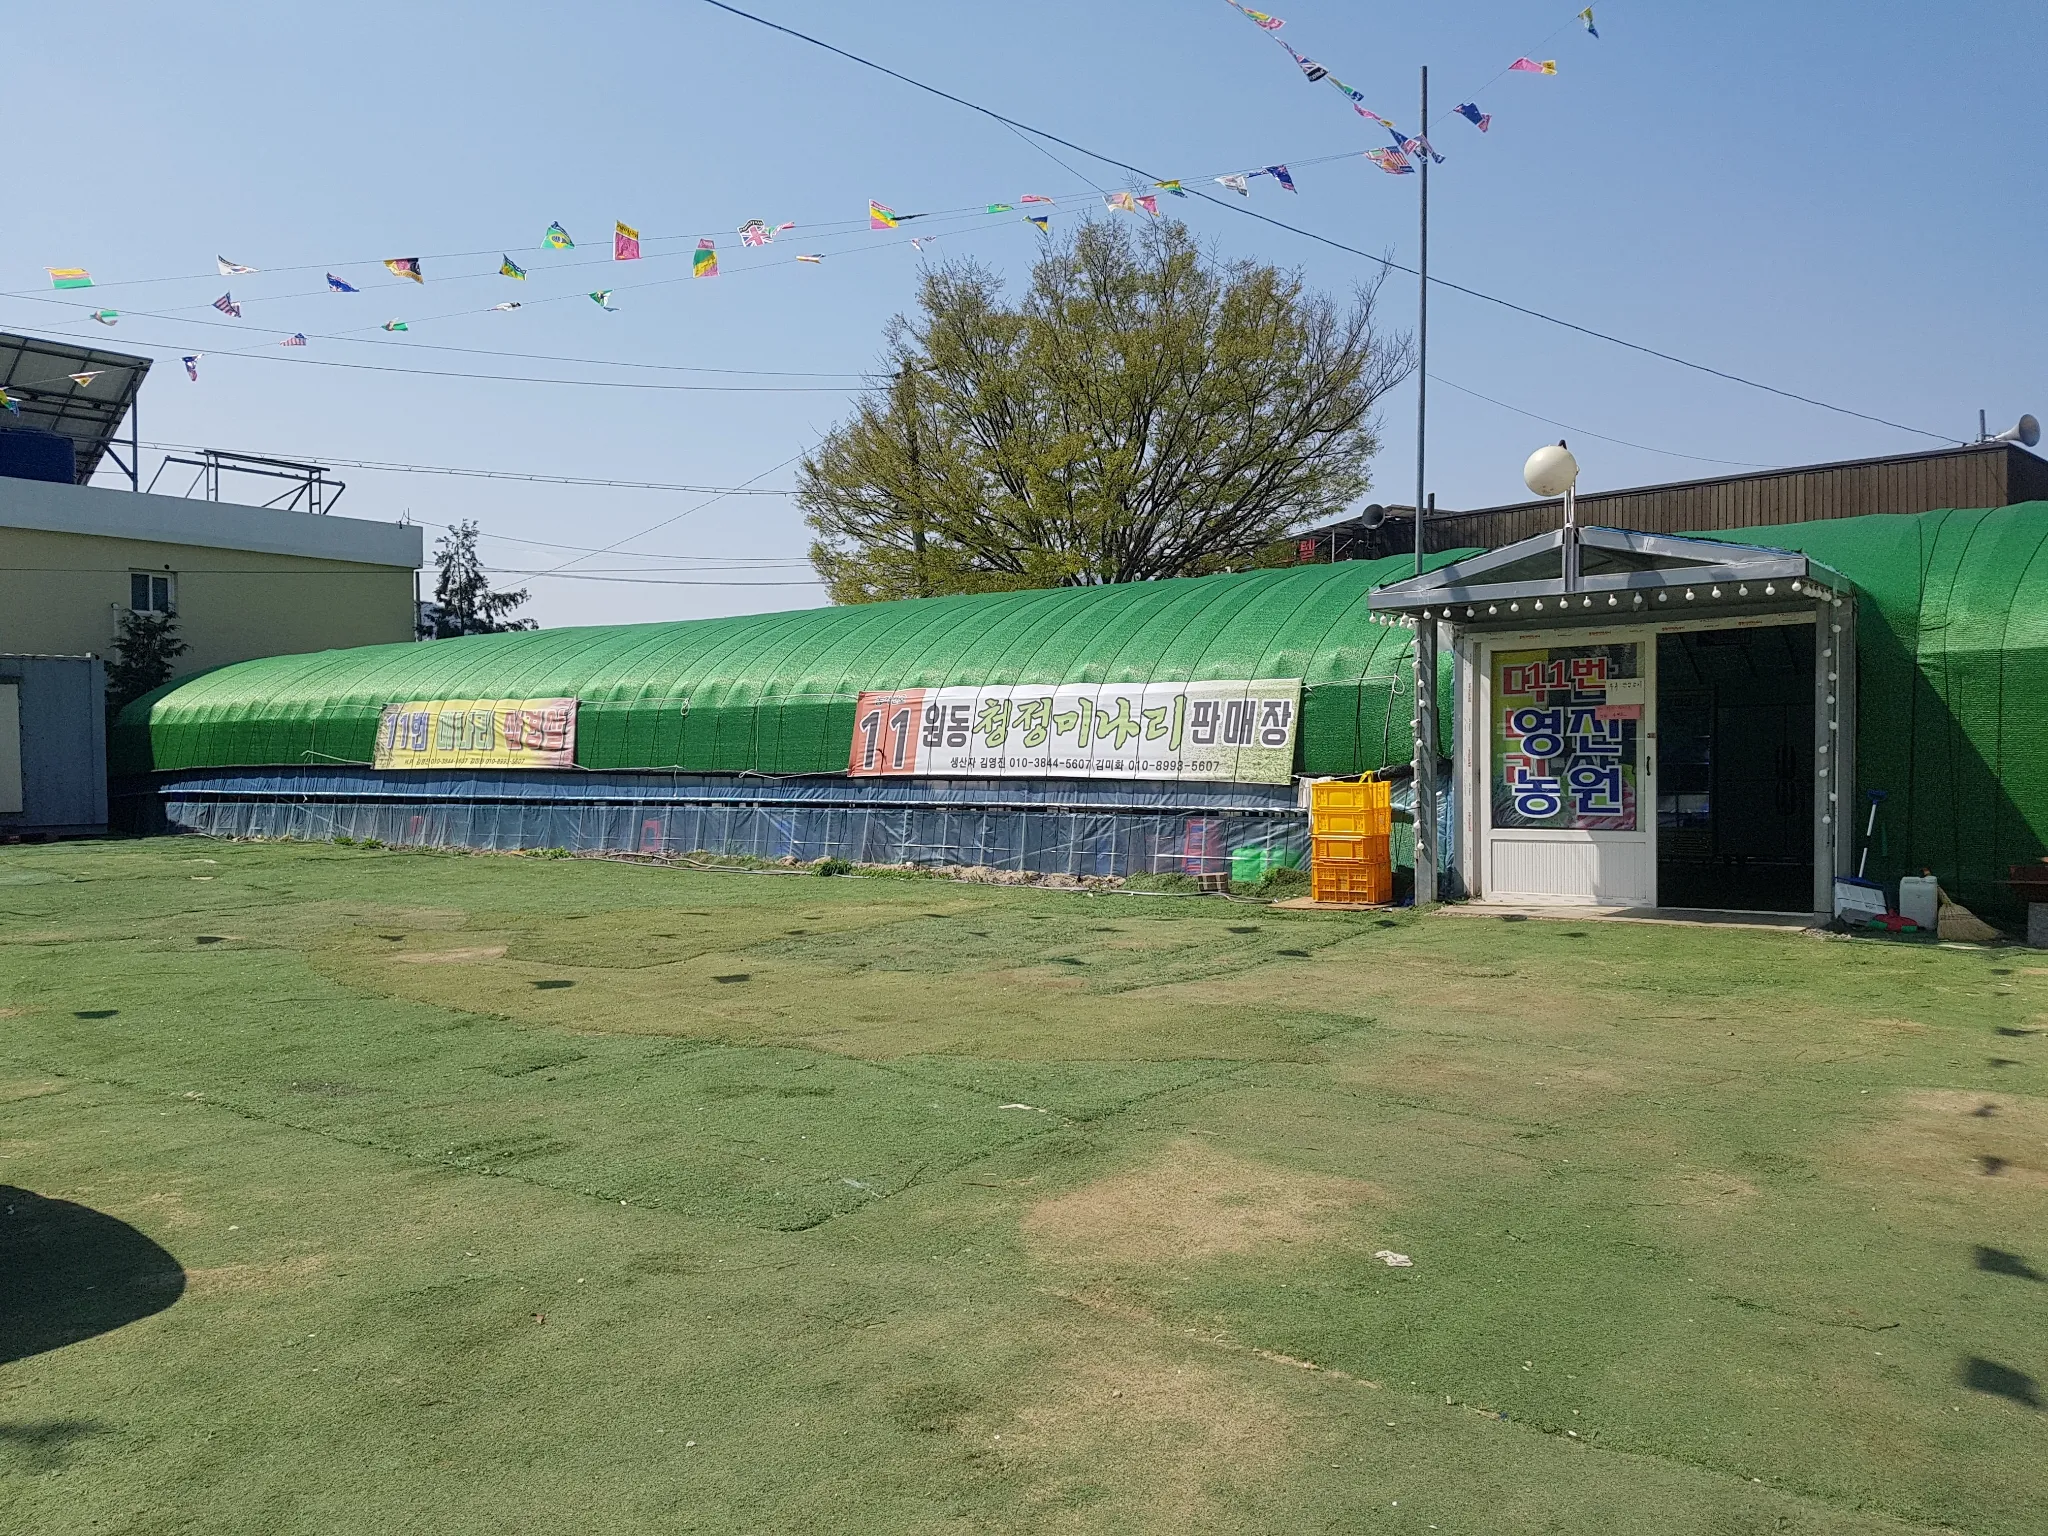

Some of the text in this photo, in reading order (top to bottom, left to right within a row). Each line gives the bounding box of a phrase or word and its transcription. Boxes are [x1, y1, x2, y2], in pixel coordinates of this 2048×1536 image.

[1526, 659, 1607, 691] 11번
[387, 711, 429, 751] 11번
[860, 708, 912, 769] 11
[922, 694, 1292, 751] 원동 청정미나리 판매장
[1511, 707, 1623, 759] 영진
[950, 757, 976, 770] 생산자
[980, 757, 1006, 769] 김영진
[1009, 757, 1091, 770] 010-3844-5607
[1095, 759, 1124, 771] 김미화
[1512, 765, 1623, 819] 농원
